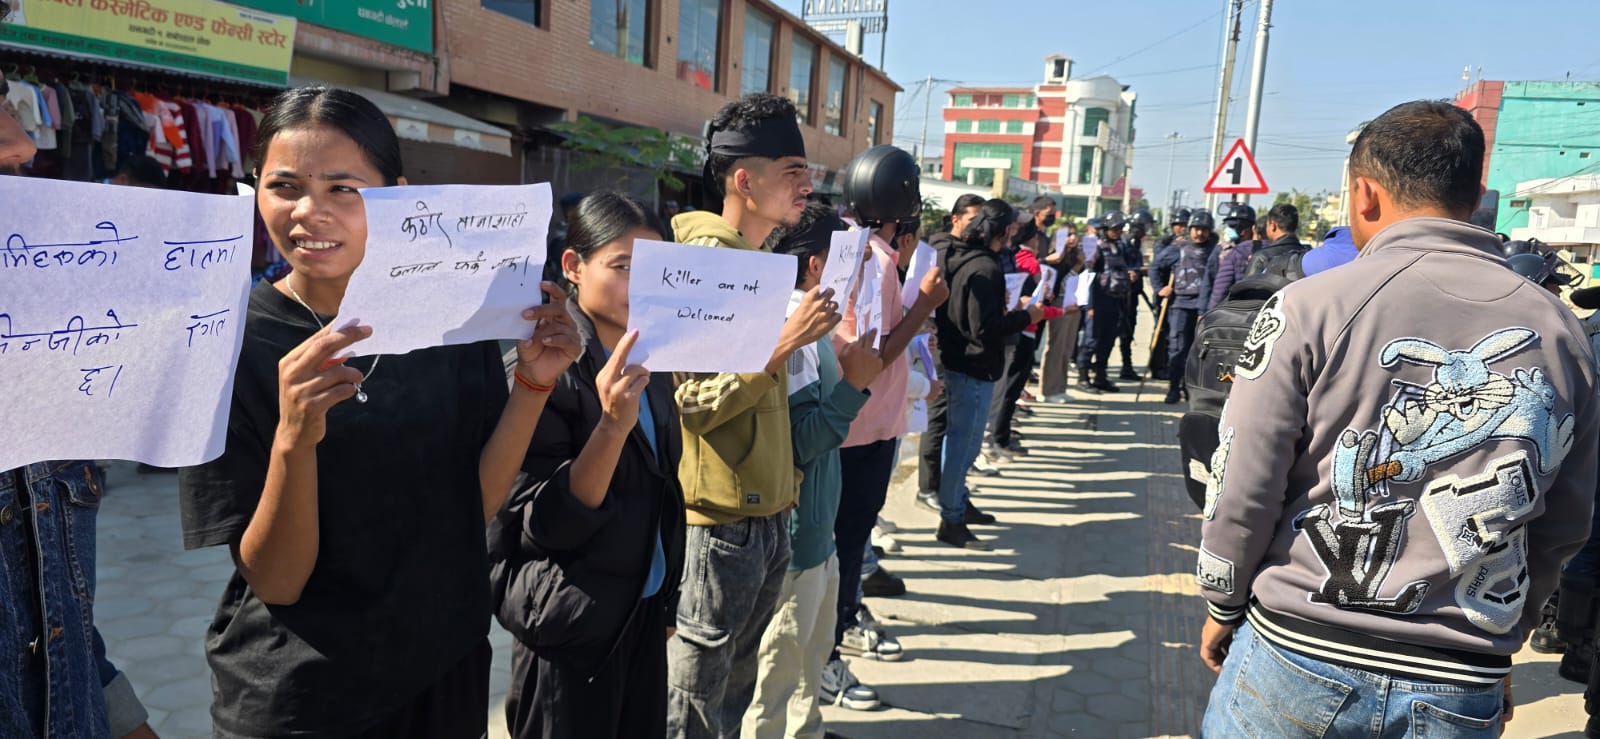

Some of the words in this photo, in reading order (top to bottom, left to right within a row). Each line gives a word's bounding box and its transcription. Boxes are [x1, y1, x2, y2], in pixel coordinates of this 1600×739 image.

[257, 28, 287, 49] स्टोर
[662, 266, 702, 289] Killer
[718, 282, 735, 290] are
[743, 279, 760, 295] not
[1508, 471, 1527, 507] LOUIS
[1467, 565, 1491, 599] PARIS
